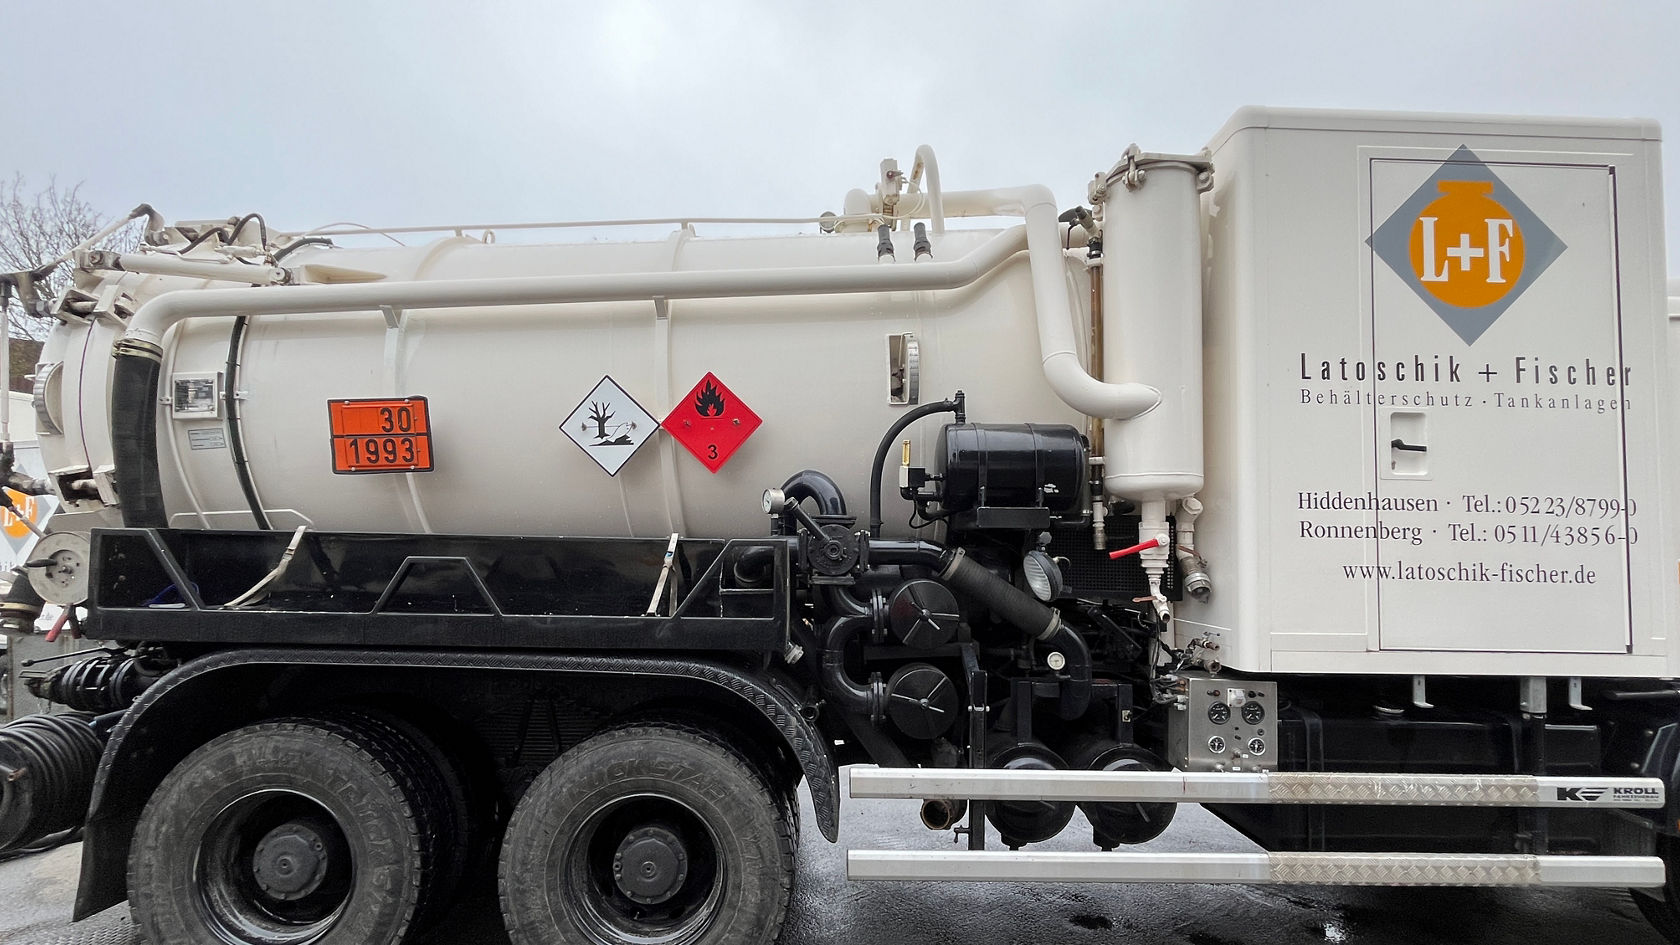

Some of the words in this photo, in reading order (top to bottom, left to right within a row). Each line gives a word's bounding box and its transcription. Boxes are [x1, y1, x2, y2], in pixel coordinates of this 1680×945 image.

[1419, 216, 1513, 283] L+F
[1300, 353, 1461, 382] Latoschik
[1515, 357, 1632, 386] Fischer
[1300, 389, 1473, 407] Behälterschutz
[1494, 392, 1632, 414] Tankanlagen
[380, 407, 411, 433] 30
[349, 437, 415, 464] 1993
[707, 444, 718, 460] 3
[1298, 492, 1439, 513] Hiddenhausen
[1300, 520, 1423, 545] Ronnenberg
[1448, 523, 1487, 542] Tel.:
[1343, 561, 1597, 584] www.latoschik-fischer.de
